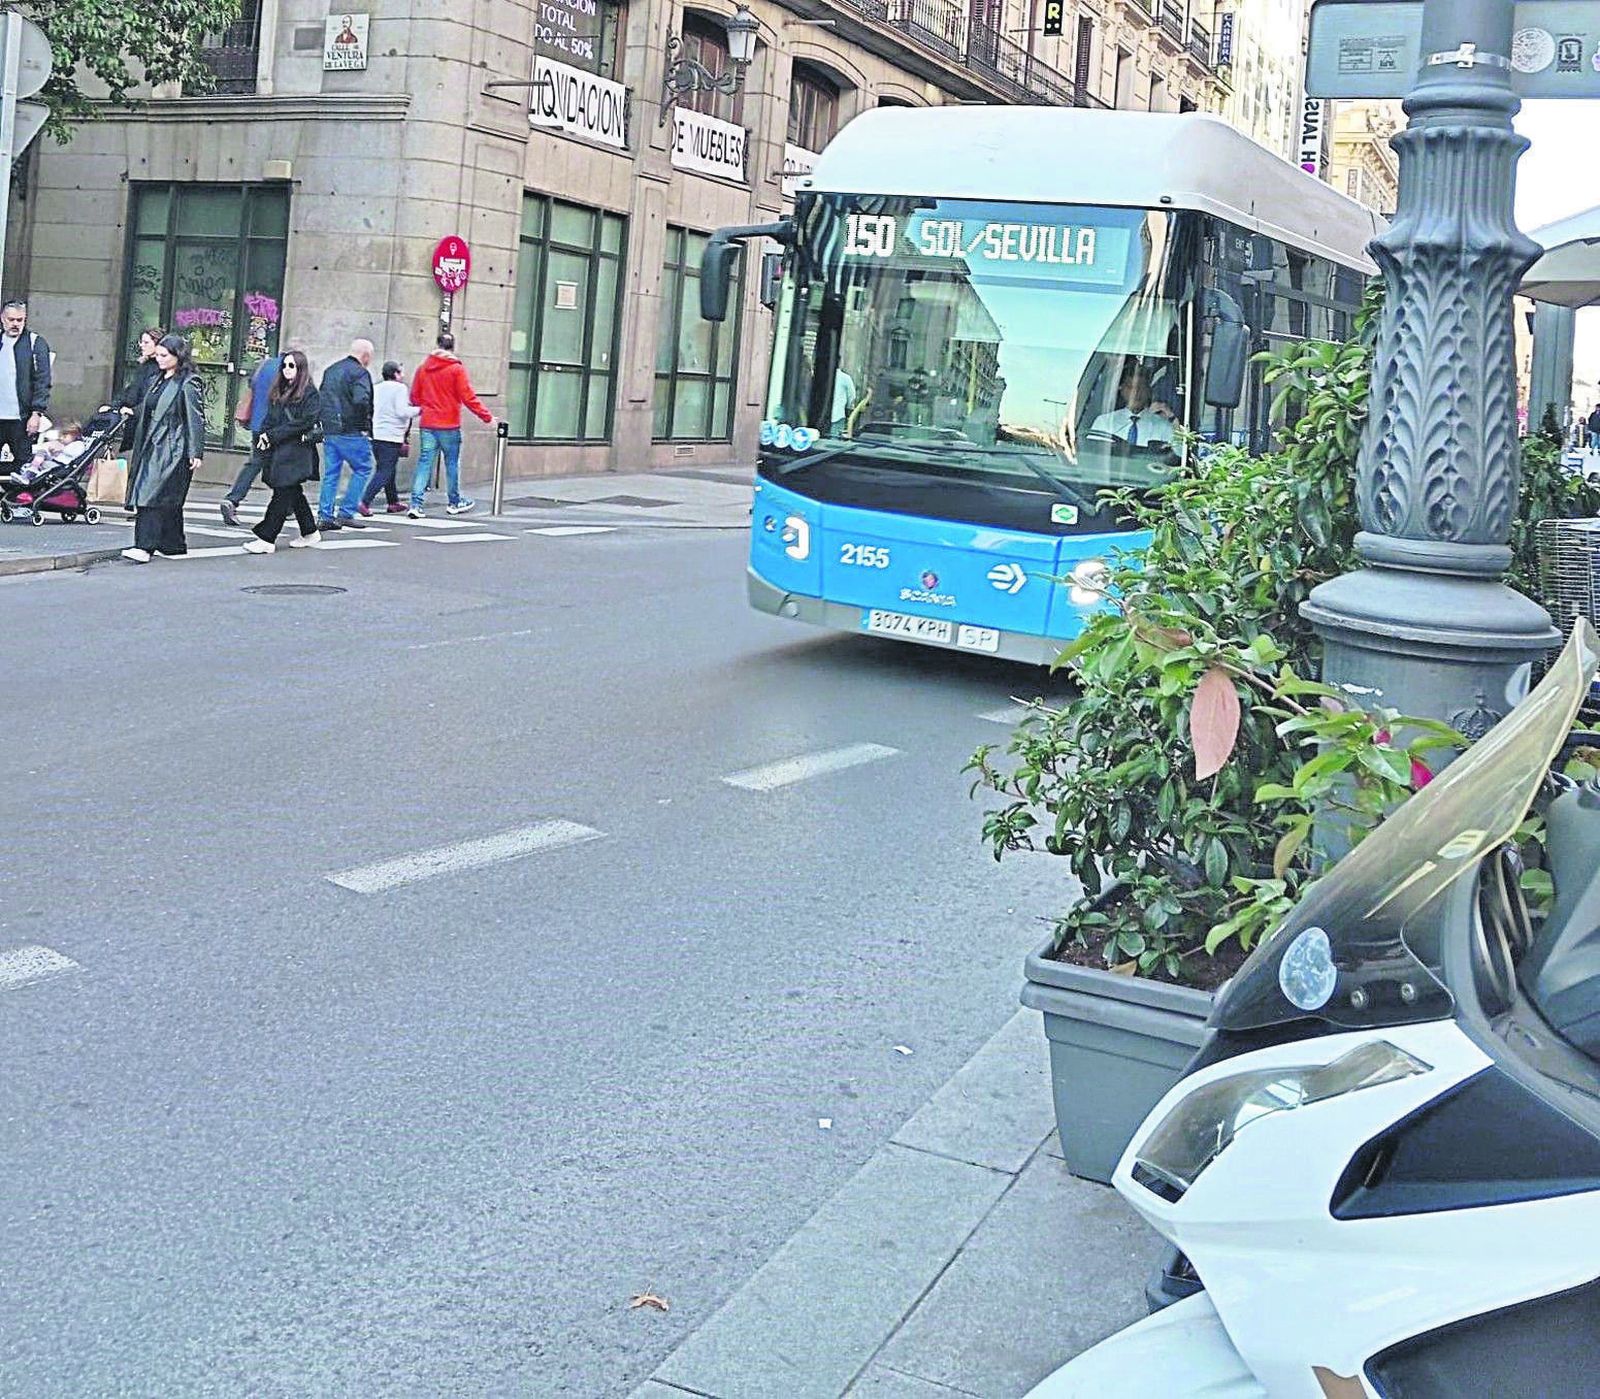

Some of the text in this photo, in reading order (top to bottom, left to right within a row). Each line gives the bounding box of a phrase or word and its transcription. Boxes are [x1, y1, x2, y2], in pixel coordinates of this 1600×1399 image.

[540, 2, 577, 32] TOTAL
[327, 51, 363, 60] VENTURA
[553, 31, 569, 51] AL
[571, 37, 593, 60] 50%
[1302, 97, 1319, 145] SUAL
[690, 123, 742, 168] MUEBLES
[845, 213, 896, 257] 150
[840, 543, 890, 569] 2155
[874, 611, 947, 638] 3074 KPH
[966, 628, 992, 646] SP
